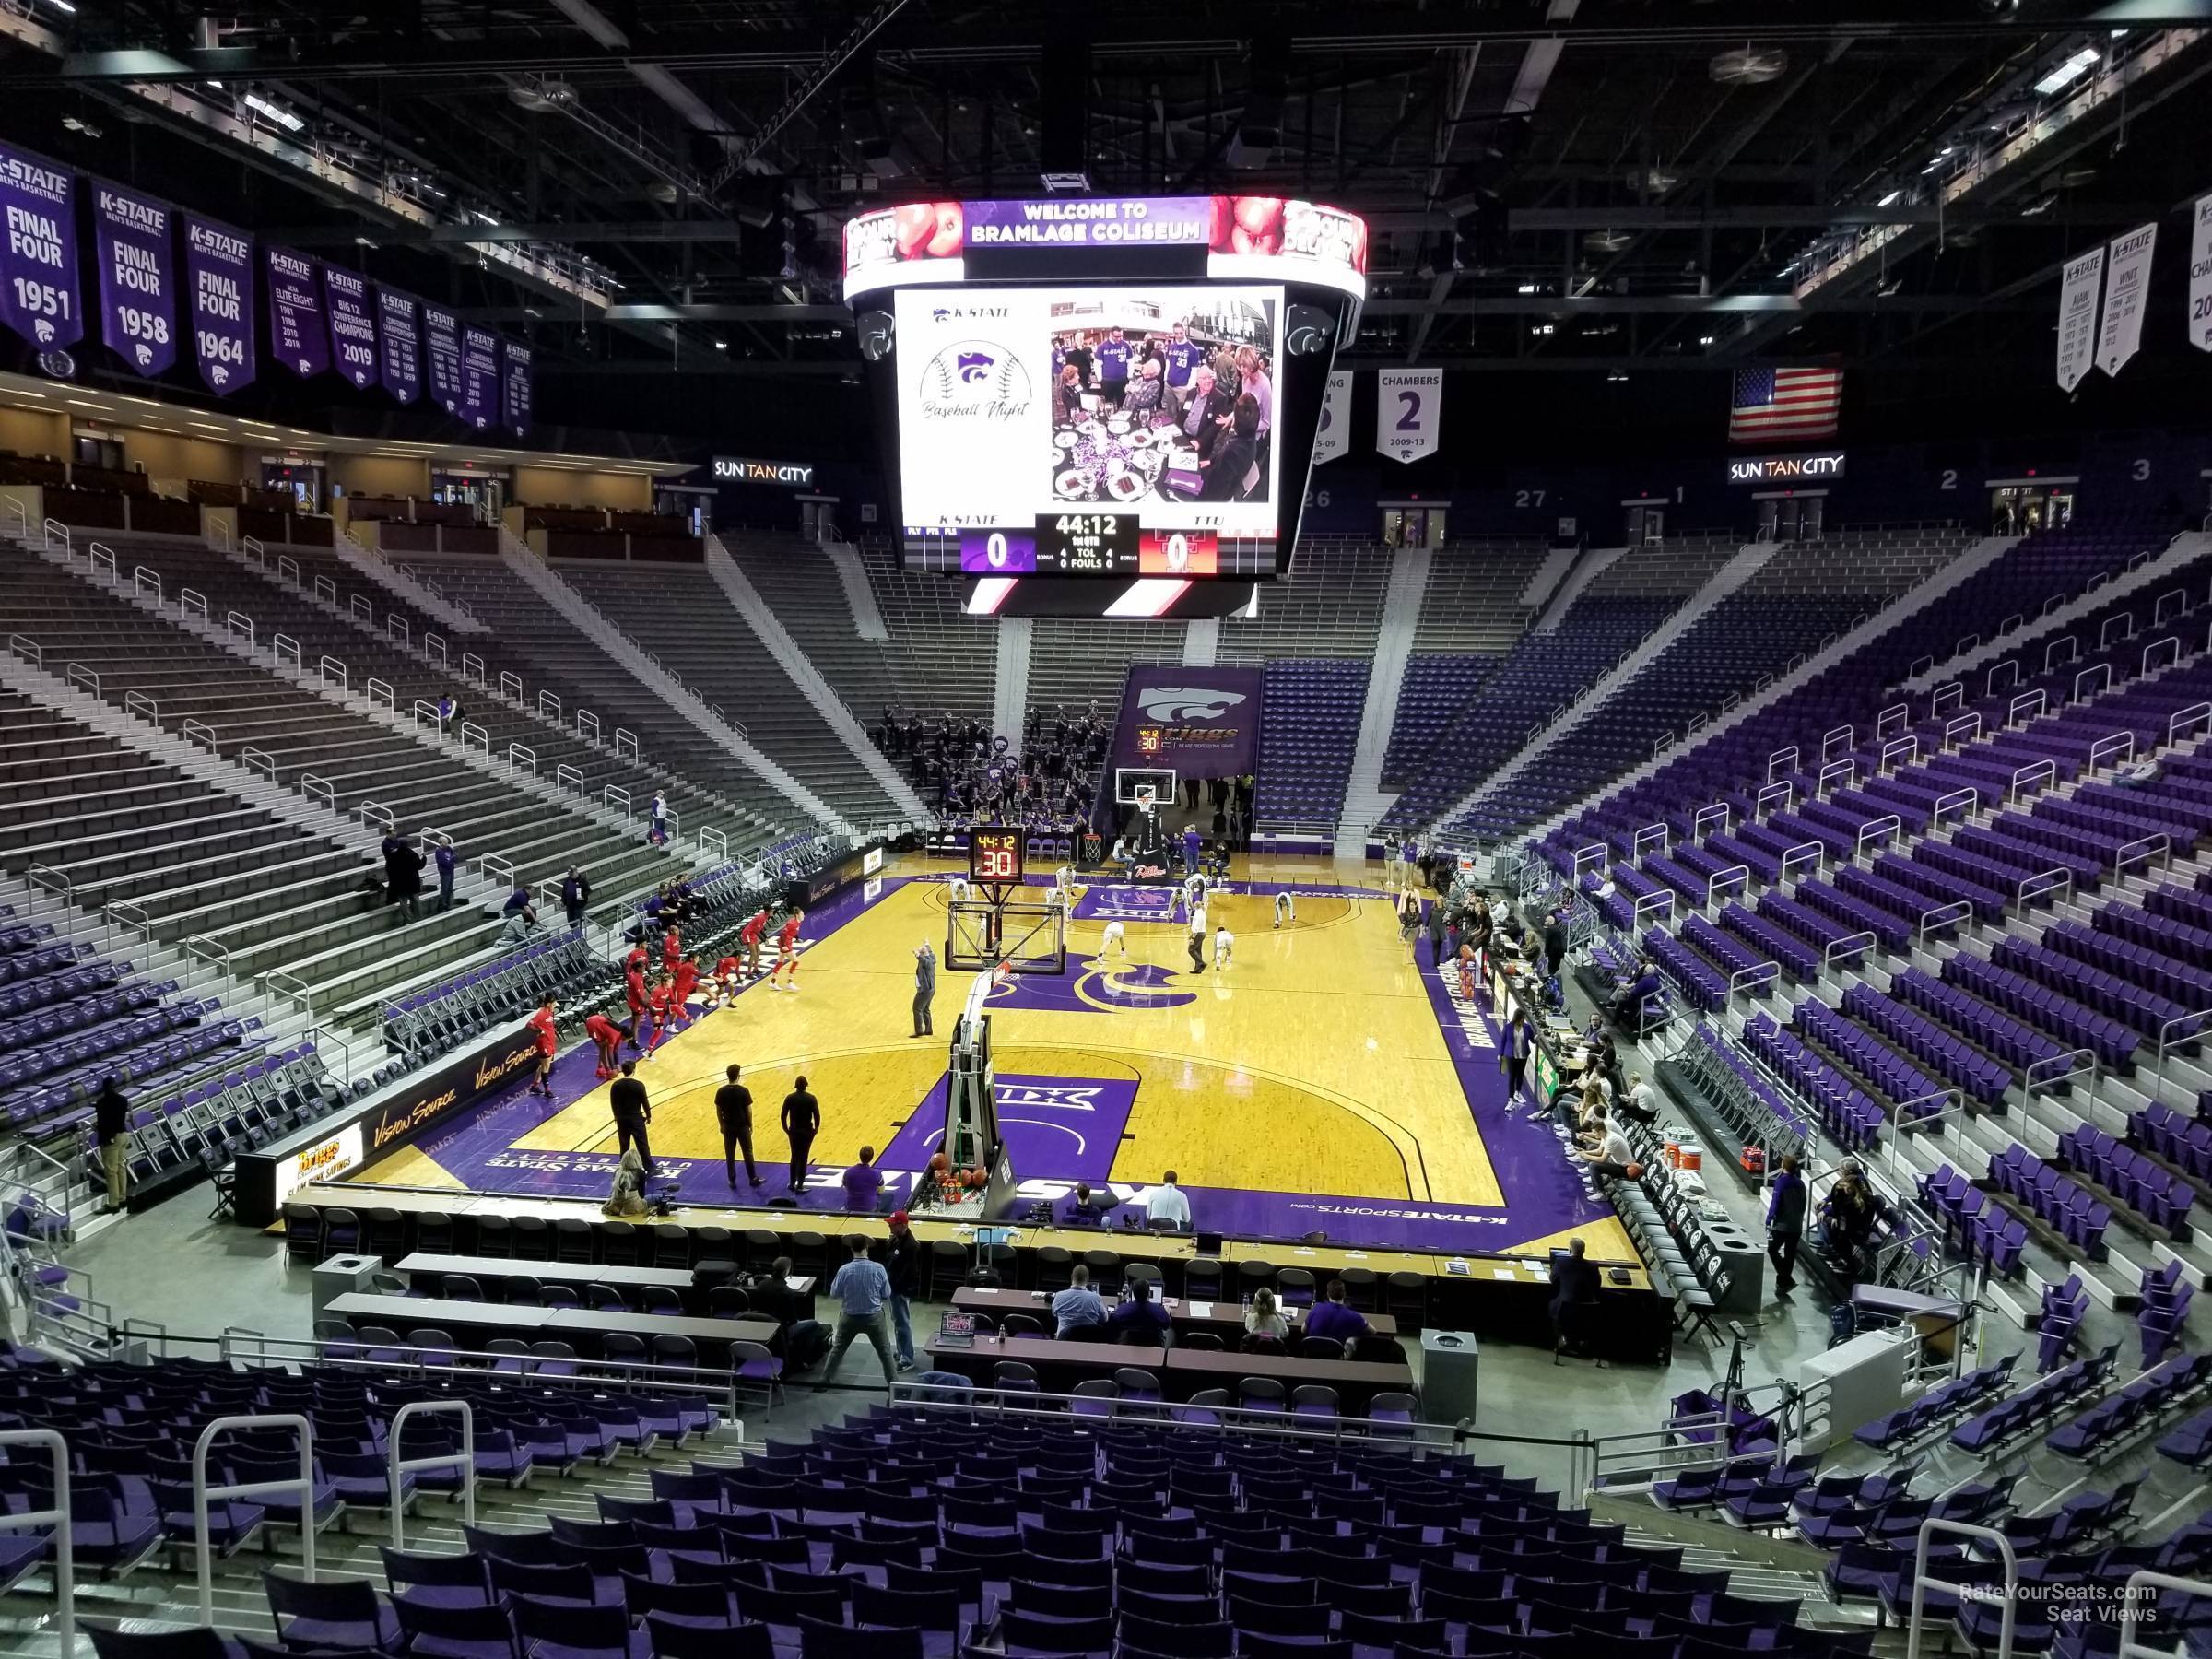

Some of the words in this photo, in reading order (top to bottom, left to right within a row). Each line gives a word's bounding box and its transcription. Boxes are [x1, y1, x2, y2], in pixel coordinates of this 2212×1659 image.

[0, 154, 67, 195] -STATE
[20, 182, 64, 204] BASKETBALL
[100, 191, 164, 229] K-STATE
[1023, 203, 1117, 220] WELCOME
[1122, 203, 1147, 219] TO
[6, 205, 63, 245] FINAL
[971, 223, 1088, 243] BRAMLAGE
[1091, 222, 1201, 241] COLISEUM
[9, 230, 63, 268] FOUR
[190, 225, 247, 259] K-STATE
[2113, 230, 2152, 260] K-STATE
[113, 241, 159, 275] FINAL
[270, 252, 310, 276] K-STATE
[2066, 254, 2100, 282] K-STATE
[115, 264, 160, 297] FOUR
[198, 270, 241, 300] FINAL
[327, 270, 362, 292] K-STATE
[13, 278, 69, 320] 1951
[198, 291, 240, 321] FOUR
[276, 288, 292, 302] ELITE
[293, 293, 314, 307] EIGHT
[337, 300, 351, 312] BIG
[351, 303, 360, 315] 12
[381, 292, 412, 313] K-STATE
[118, 306, 169, 344] 1958
[333, 310, 372, 329] CONFERENCE
[426, 309, 455, 329] K-STATE
[334, 320, 374, 342] CHAMPIONS
[467, 330, 495, 348] K-STATE
[198, 330, 243, 365] 1964
[342, 343, 372, 366] 2019
[506, 343, 531, 361] K-STATE
[1381, 376, 1440, 386] CHAMBERS
[922, 400, 980, 419] Baseball
[985, 400, 1030, 421] Night
[1395, 390, 1421, 431] 2
[1390, 438, 1425, 447] 2009-13
[714, 460, 745, 477] SUN
[746, 464, 777, 479] TAN
[778, 466, 812, 483] CITY
[1731, 462, 1763, 479] SUN
[1765, 460, 1801, 477] TAN
[1802, 454, 1844, 475] CITY
[2132, 459, 2151, 481] 3
[1940, 469, 1958, 490] 2
[1515, 490, 1546, 508] 27
[1676, 486, 1684, 504] 1
[1055, 515, 1117, 535] 44:12
[1194, 516, 1225, 526] TTU
[986, 532, 1007, 568] 0
[1060, 547, 1067, 558] 4
[1077, 547, 1096, 558] TOL
[1106, 547, 1113, 559] 4
[1167, 534, 1188, 570] 0
[1060, 559, 1067, 569] 0
[1070, 559, 1102, 569] FOULS
[1106, 559, 1113, 569] 0
[1141, 737, 1157, 750] 30
[1162, 724, 1239, 741] riggs
[978, 835, 1015, 850] 44:12
[982, 851, 1012, 877] 30
[298, 1140, 340, 1173] Briggs
[325, 1156, 351, 1178] SAVINGS
[485, 1159, 569, 1172] STATE
[498, 1152, 693, 1170] UNERSITY
[572, 1162, 688, 1179] KSAS
